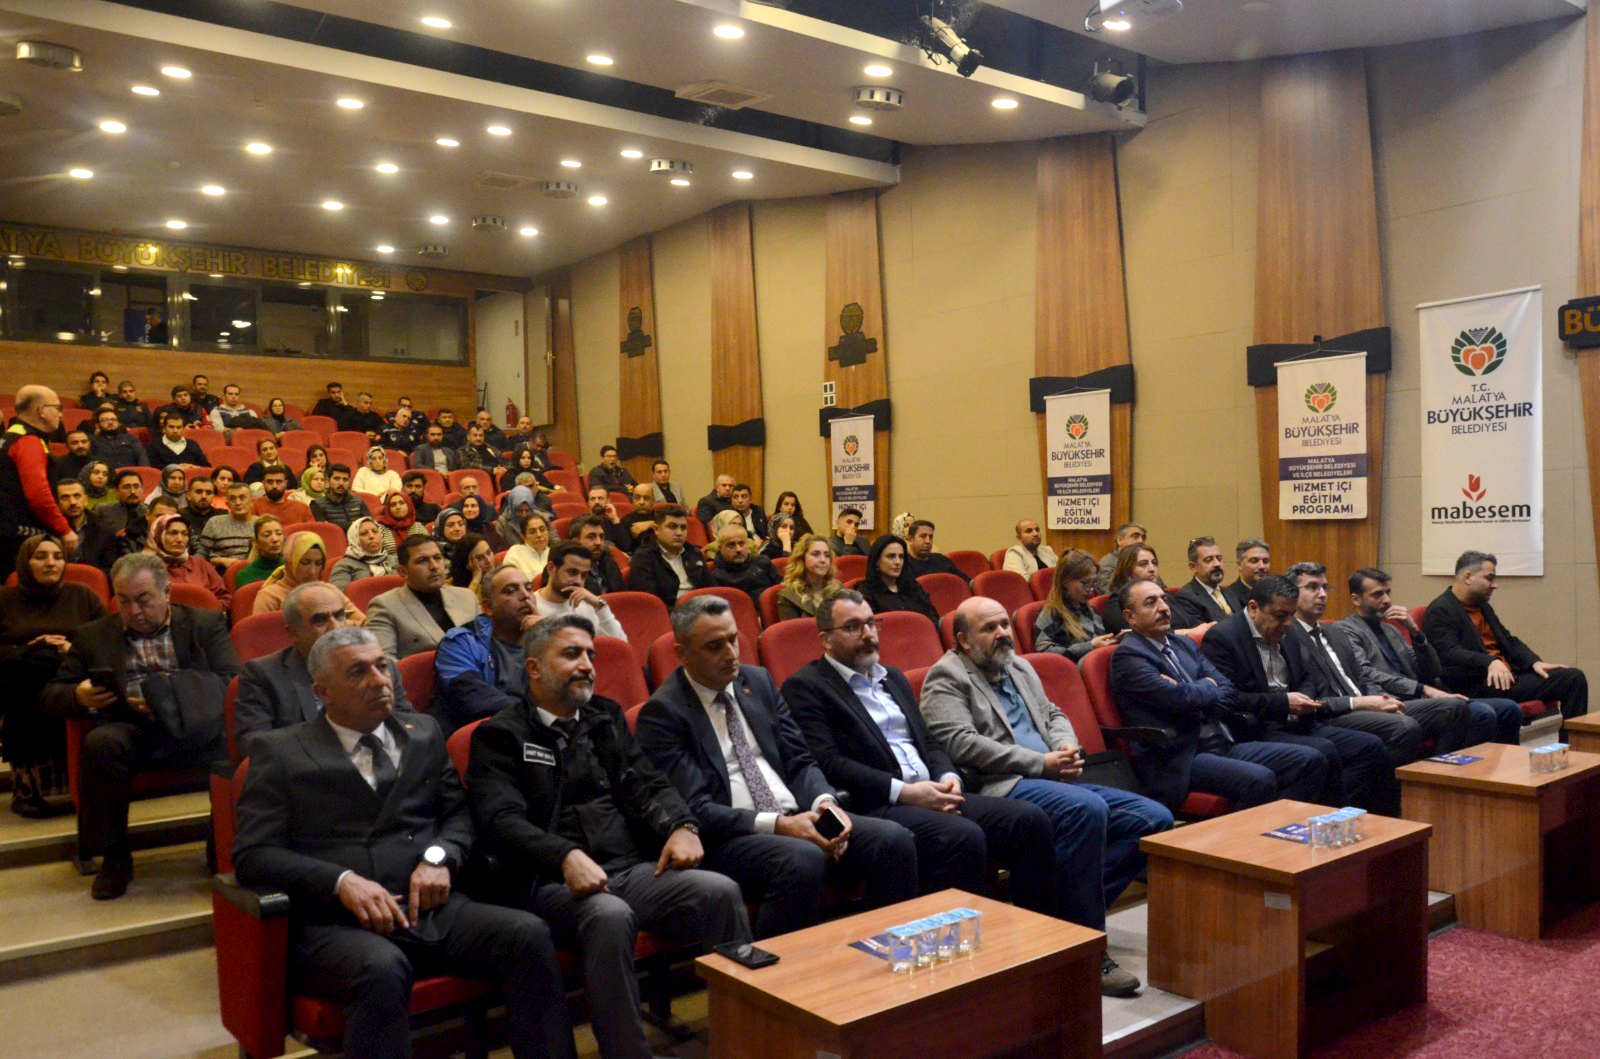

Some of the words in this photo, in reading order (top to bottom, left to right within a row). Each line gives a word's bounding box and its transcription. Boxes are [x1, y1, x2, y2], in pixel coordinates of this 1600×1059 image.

[1471, 383, 1490, 392] T.C.
[1451, 392, 1507, 405] MALATYA
[1302, 414, 1340, 424] MALATYA
[1427, 402, 1533, 424] BÜYÜKŞEHİR
[1285, 422, 1359, 438] BÜYÜKŞEHİR
[1451, 421, 1507, 434] BELEDİYESİ
[1302, 437, 1342, 447] BELEDİYESİ
[1052, 448, 1105, 461] BÜYÜKŞEHİR
[1294, 482, 1334, 492] HİZMET
[1337, 481, 1352, 493] İÇİ
[1058, 498, 1087, 506] HİZMET
[1088, 498, 1100, 507] İÇİ
[1303, 492, 1342, 504] EĞİTİM
[1064, 507, 1092, 516] EĞİTİM
[1292, 504, 1354, 514] PROGRAMI
[1431, 501, 1531, 519] mabesem
[1056, 516, 1100, 524] PROGRAMI
